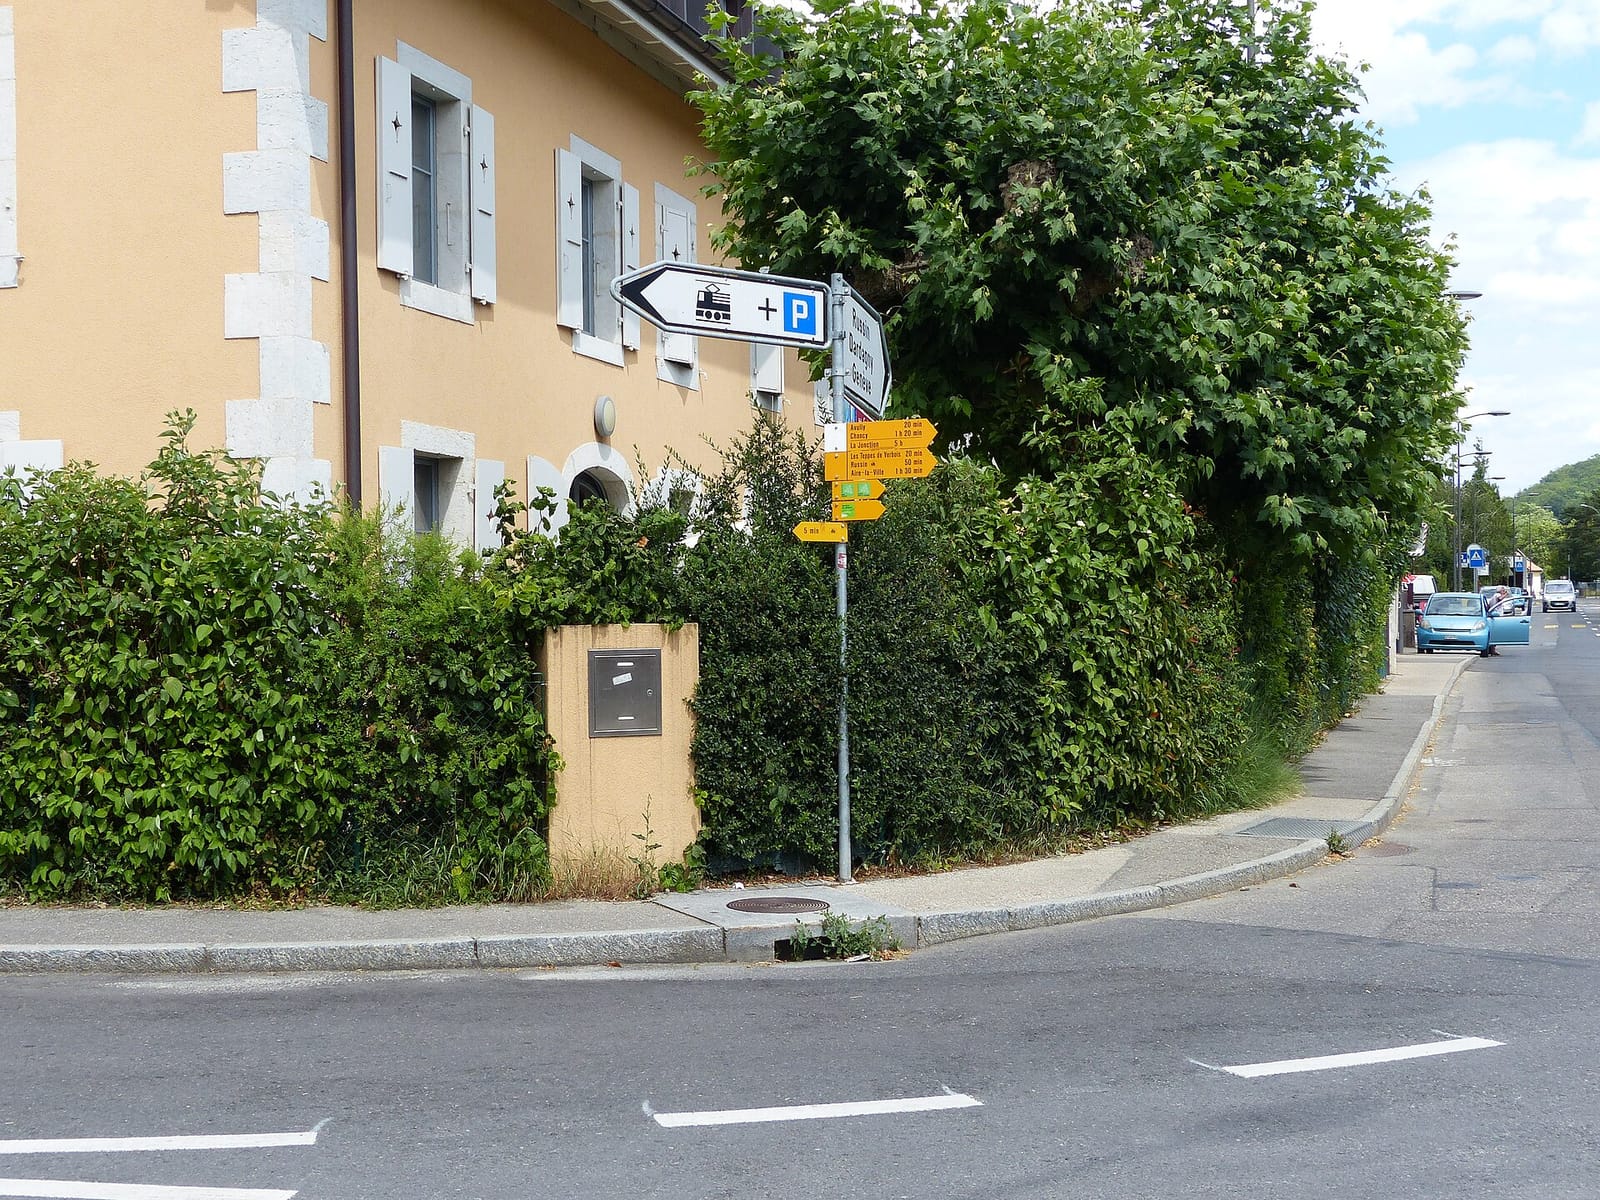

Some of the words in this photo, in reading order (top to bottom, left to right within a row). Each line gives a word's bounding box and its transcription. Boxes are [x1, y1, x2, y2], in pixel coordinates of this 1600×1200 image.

[792, 299, 808, 329] P
[852, 308, 870, 341] Russin
[849, 332, 874, 375] Dardagny
